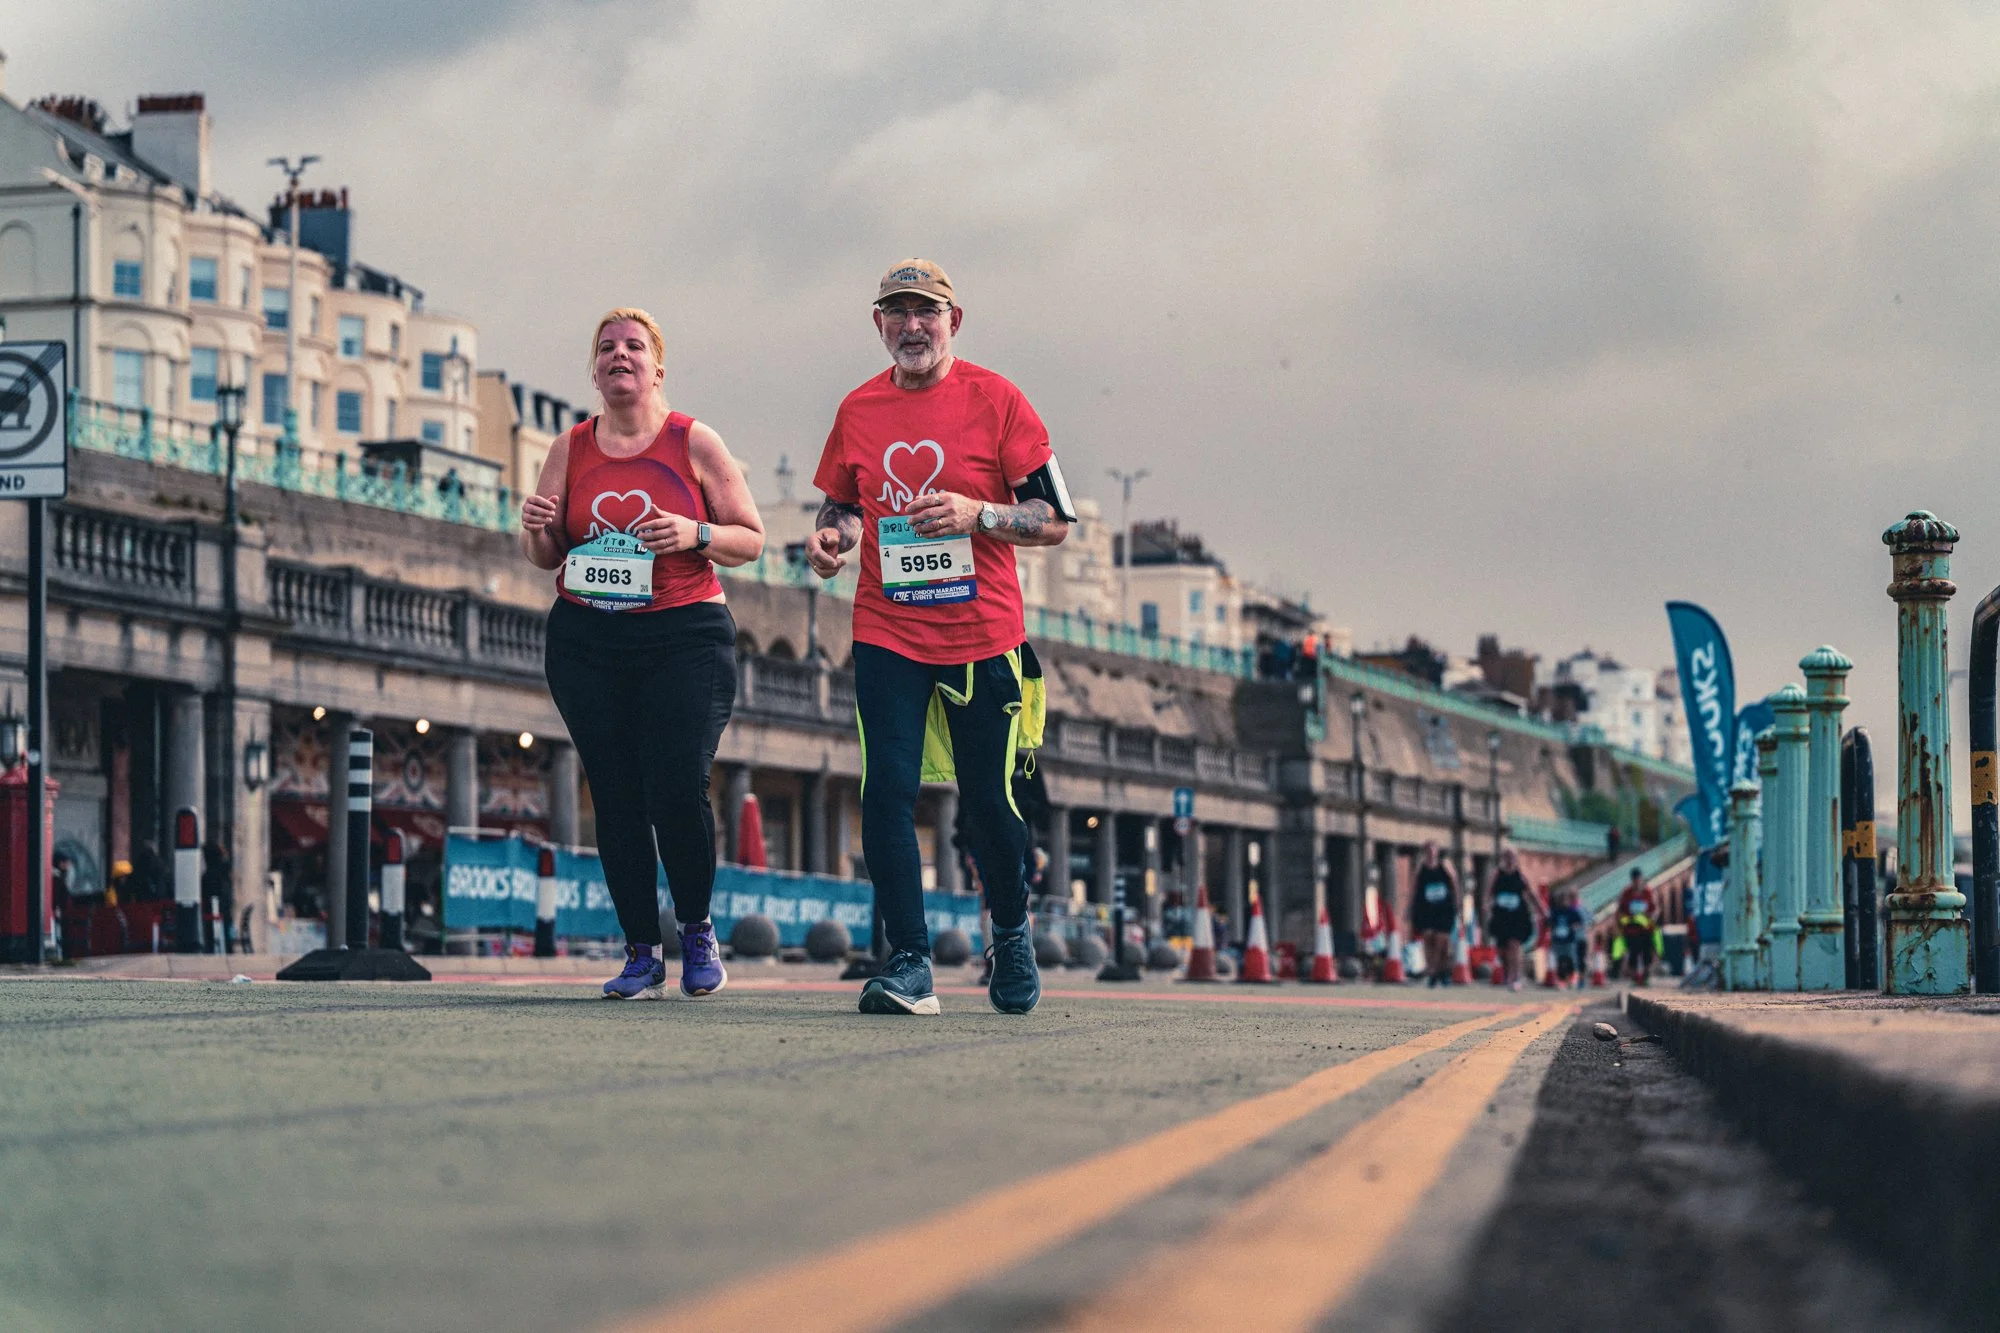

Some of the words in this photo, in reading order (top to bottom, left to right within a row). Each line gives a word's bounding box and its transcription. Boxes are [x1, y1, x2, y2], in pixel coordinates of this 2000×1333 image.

[0, 474, 25, 491] ND
[884, 550, 890, 558] 4
[901, 553, 952, 573] 5956
[585, 567, 632, 586] 8963
[936, 585, 969, 593] MARATHON
[448, 864, 511, 900] BROOKS
